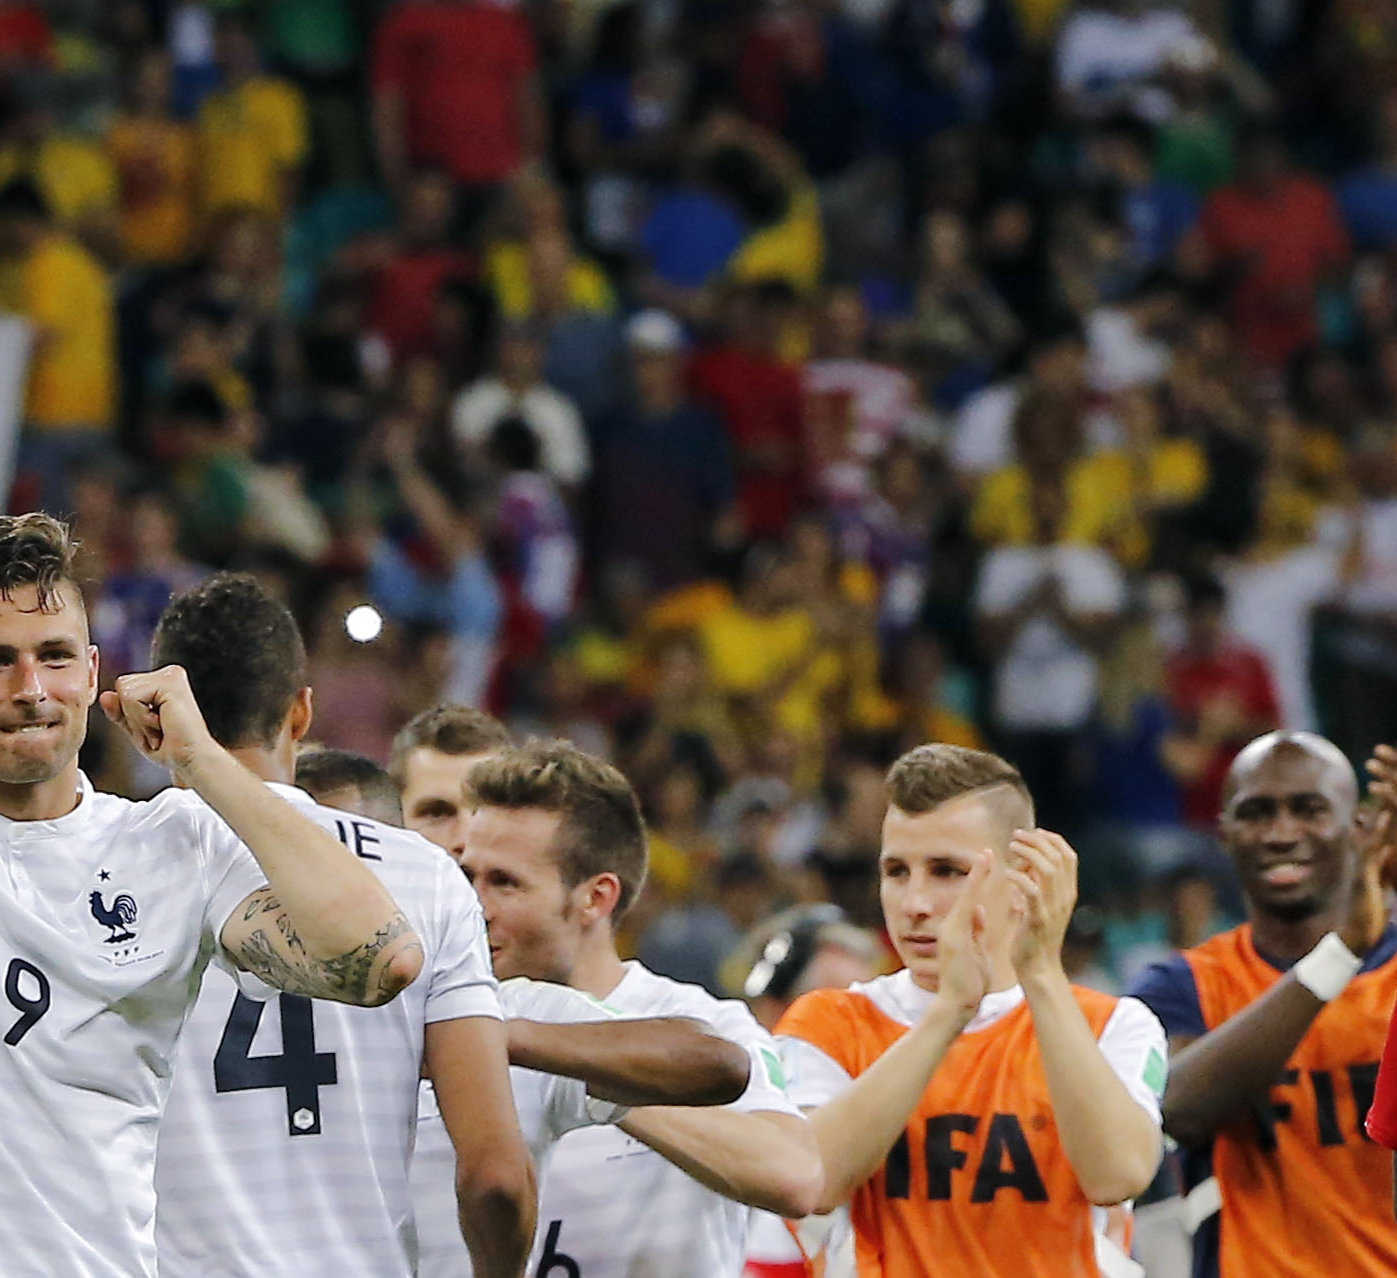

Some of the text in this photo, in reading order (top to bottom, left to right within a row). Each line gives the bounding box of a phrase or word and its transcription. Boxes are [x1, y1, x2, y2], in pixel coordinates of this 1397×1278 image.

[3, 957, 51, 1047] 9
[214, 988, 338, 1136] 4
[885, 1113, 1050, 1204] IFA
